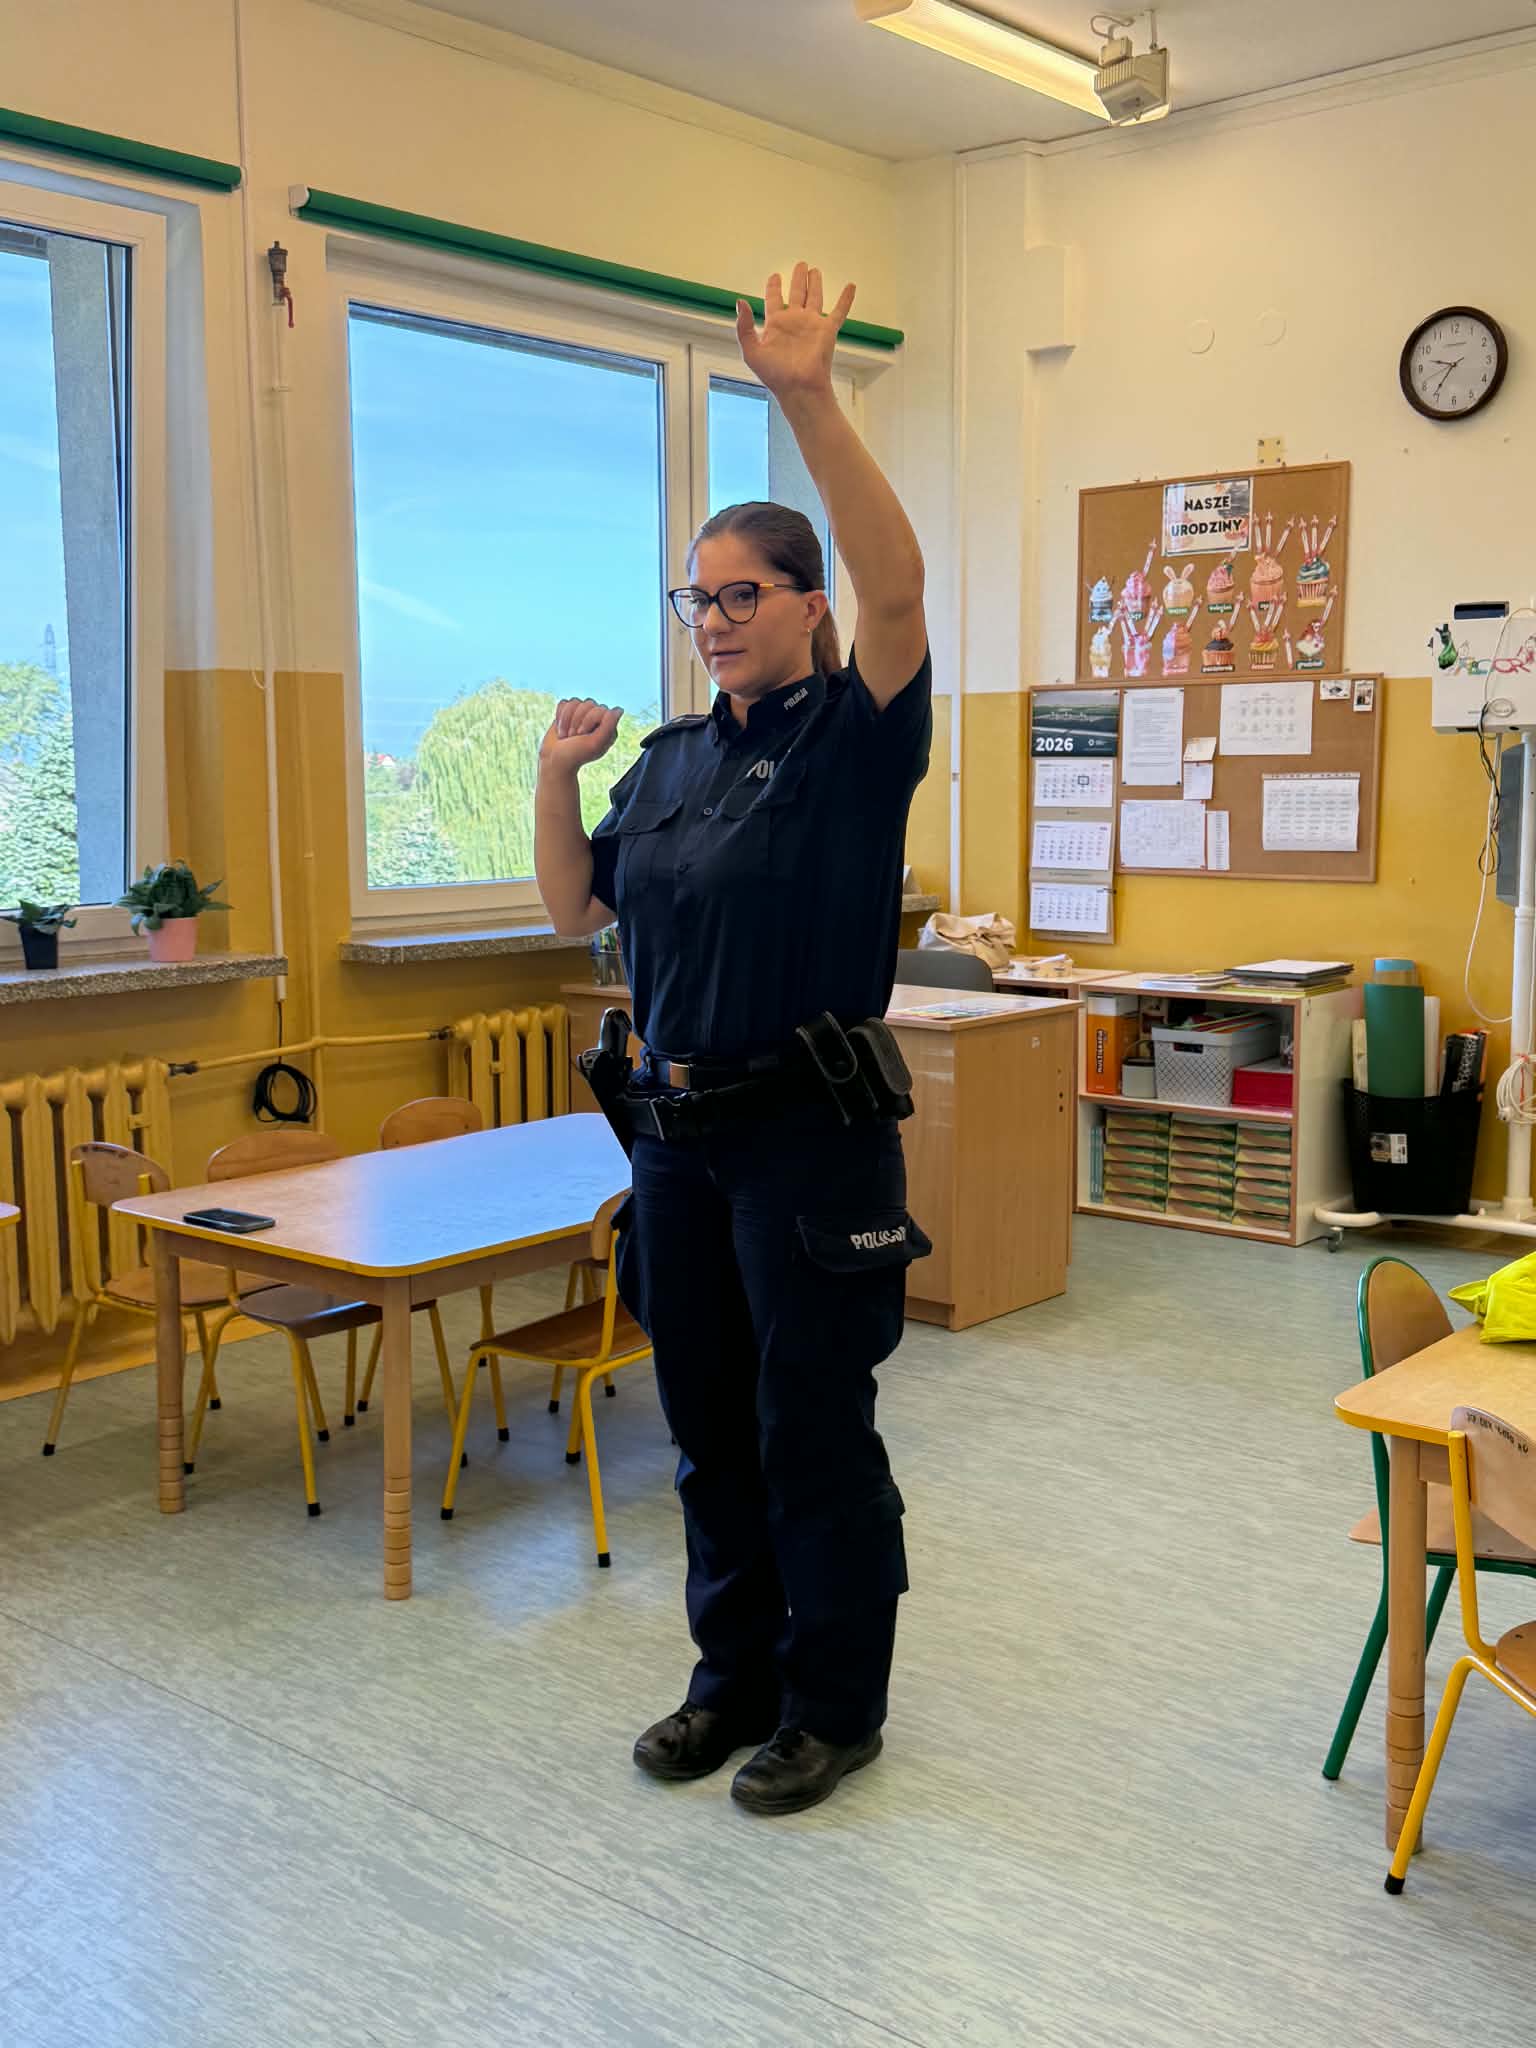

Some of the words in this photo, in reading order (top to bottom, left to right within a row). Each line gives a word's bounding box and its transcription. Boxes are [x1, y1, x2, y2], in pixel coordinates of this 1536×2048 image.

[1450, 322, 1460, 334] 12
[1469, 325, 1474, 336] 1
[1481, 336, 1487, 347] 2
[1421, 345, 1432, 356] 10
[1486, 354, 1493, 365] 3
[1481, 373, 1487, 383] 4
[1184, 496, 1230, 511] NASZE
[1171, 519, 1242, 537] URODZINY
[784, 688, 808, 711] POLICJA
[1035, 737, 1074, 752] 2026
